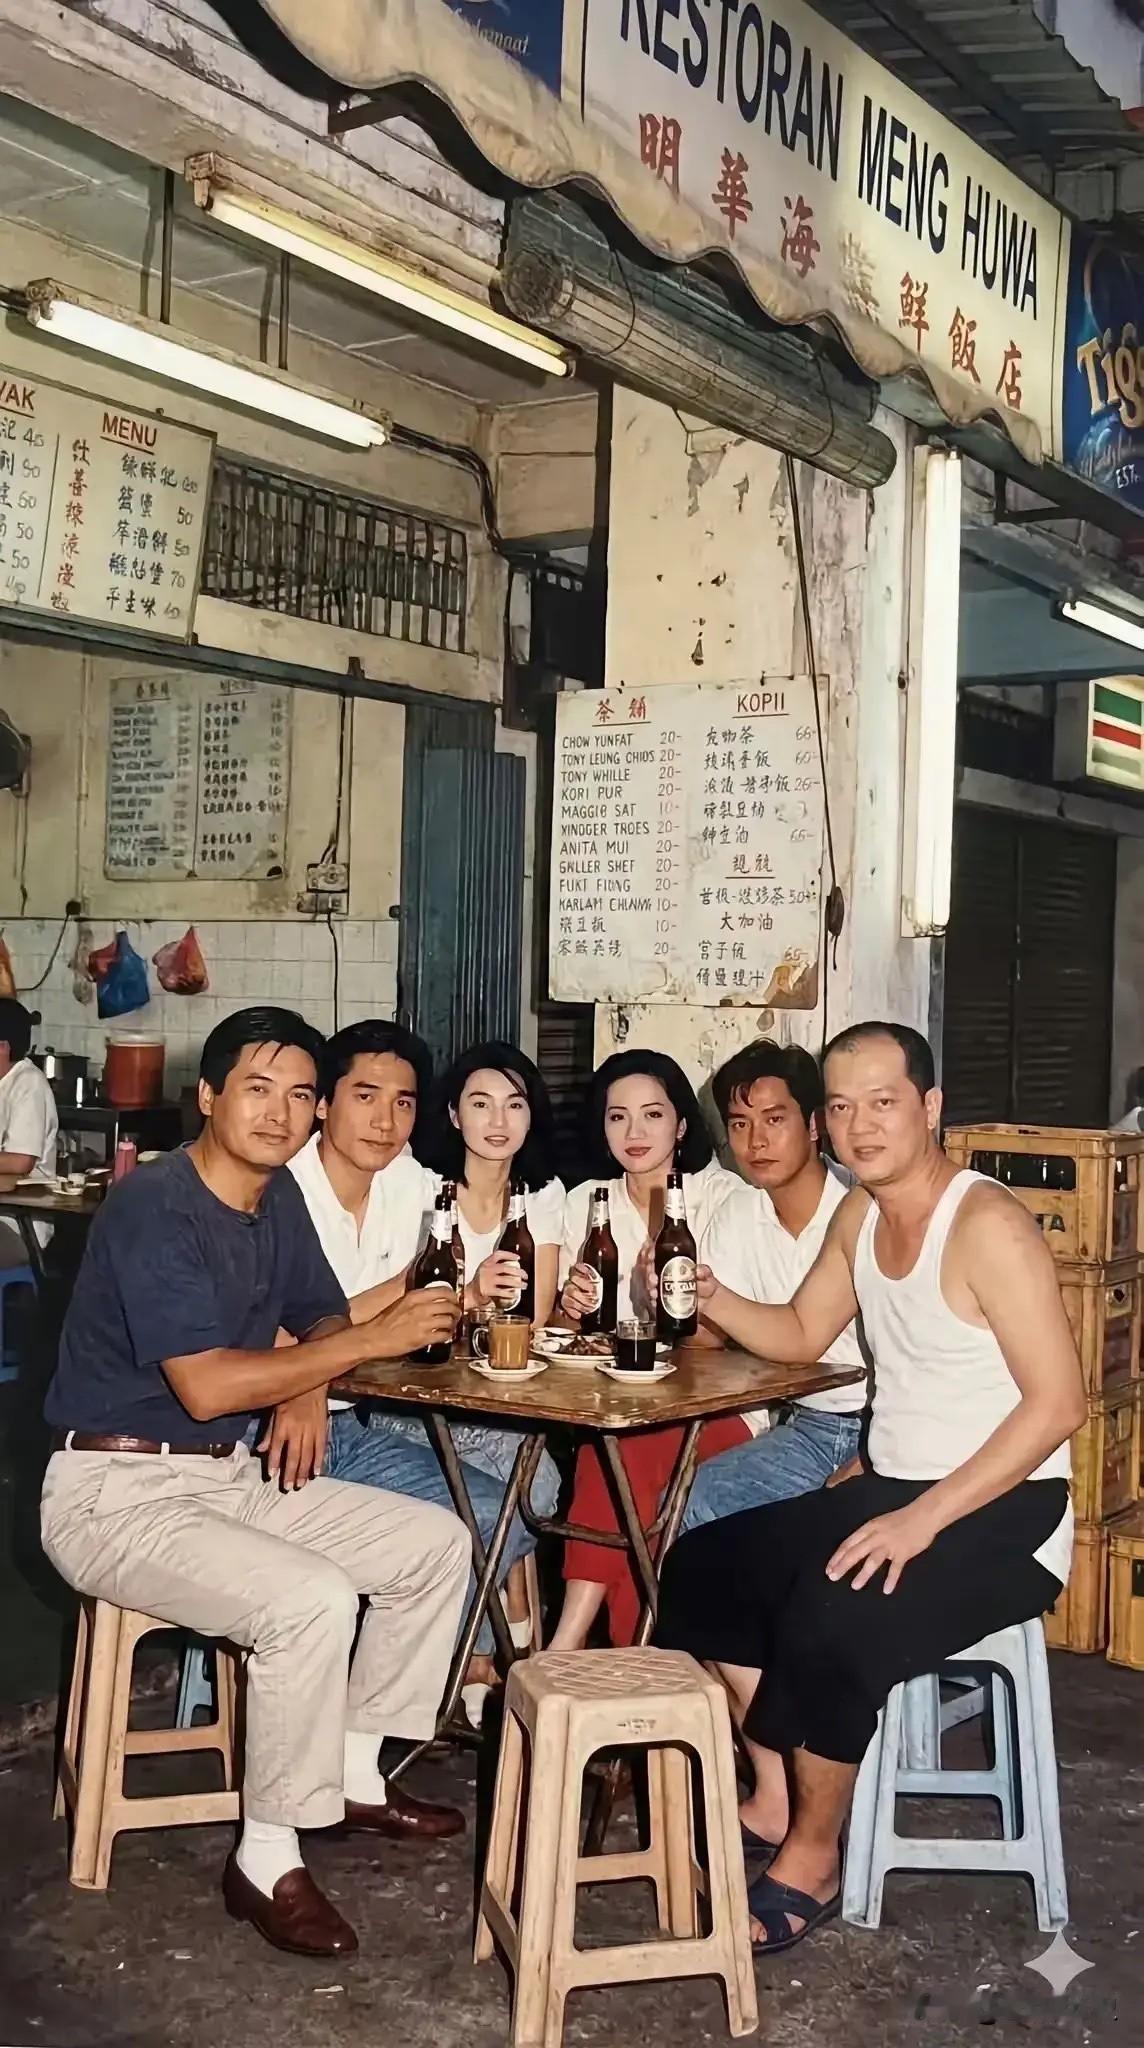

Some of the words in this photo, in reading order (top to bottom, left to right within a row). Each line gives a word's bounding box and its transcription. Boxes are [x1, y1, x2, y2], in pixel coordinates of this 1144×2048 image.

[858, 95, 949, 254] MENG
[961, 175, 1037, 321] HUWA
[102, 412, 158, 447] MENU
[177, 506, 193, 525] 50
[16, 522, 34, 540] 50
[11, 549, 30, 569] 50
[171, 570, 185, 588] 70
[737, 692, 785, 713] KOPII
[562, 736, 590, 749] CHOW
[594, 733, 635, 747] YUNFAT
[561, 754, 586, 766] TONY
[589, 751, 621, 765] LEUNG
[561, 771, 588, 784] TONY
[561, 787, 589, 801] KORI
[597, 785, 624, 799] PUR
[614, 803, 637, 818] SAT
[559, 841, 598, 856] ANITA
[606, 841, 629, 855] MUI
[720, 911, 774, 931] 大加油
